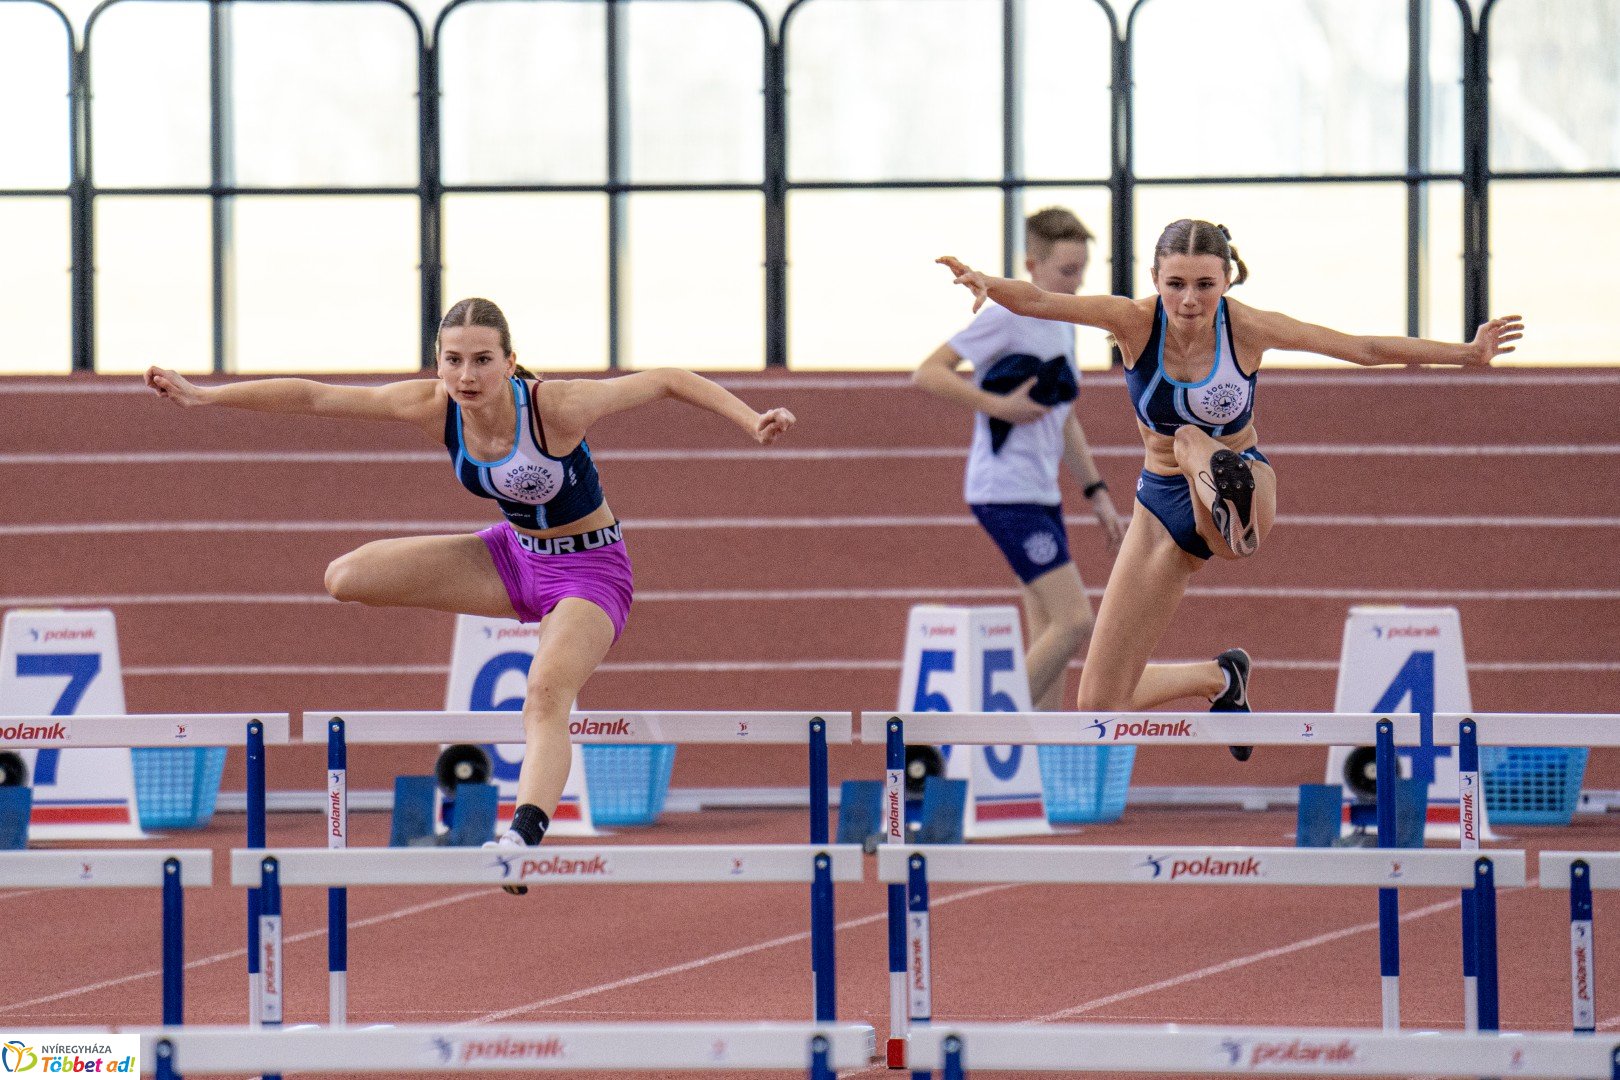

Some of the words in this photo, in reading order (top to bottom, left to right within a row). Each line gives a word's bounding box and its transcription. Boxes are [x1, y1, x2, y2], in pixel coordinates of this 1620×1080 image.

[527, 465, 552, 479] NITRA
[0, 722, 66, 740] olanik
[16, 653, 102, 787] 7
[979, 648, 1023, 782] 5
[1114, 719, 1193, 740] polanik
[1370, 650, 1452, 783] 4
[331, 791, 342, 837] polanik
[890, 791, 901, 837] polanik
[1463, 793, 1476, 840] polanik
[520, 855, 608, 879] polanik
[1170, 857, 1261, 879] polanik
